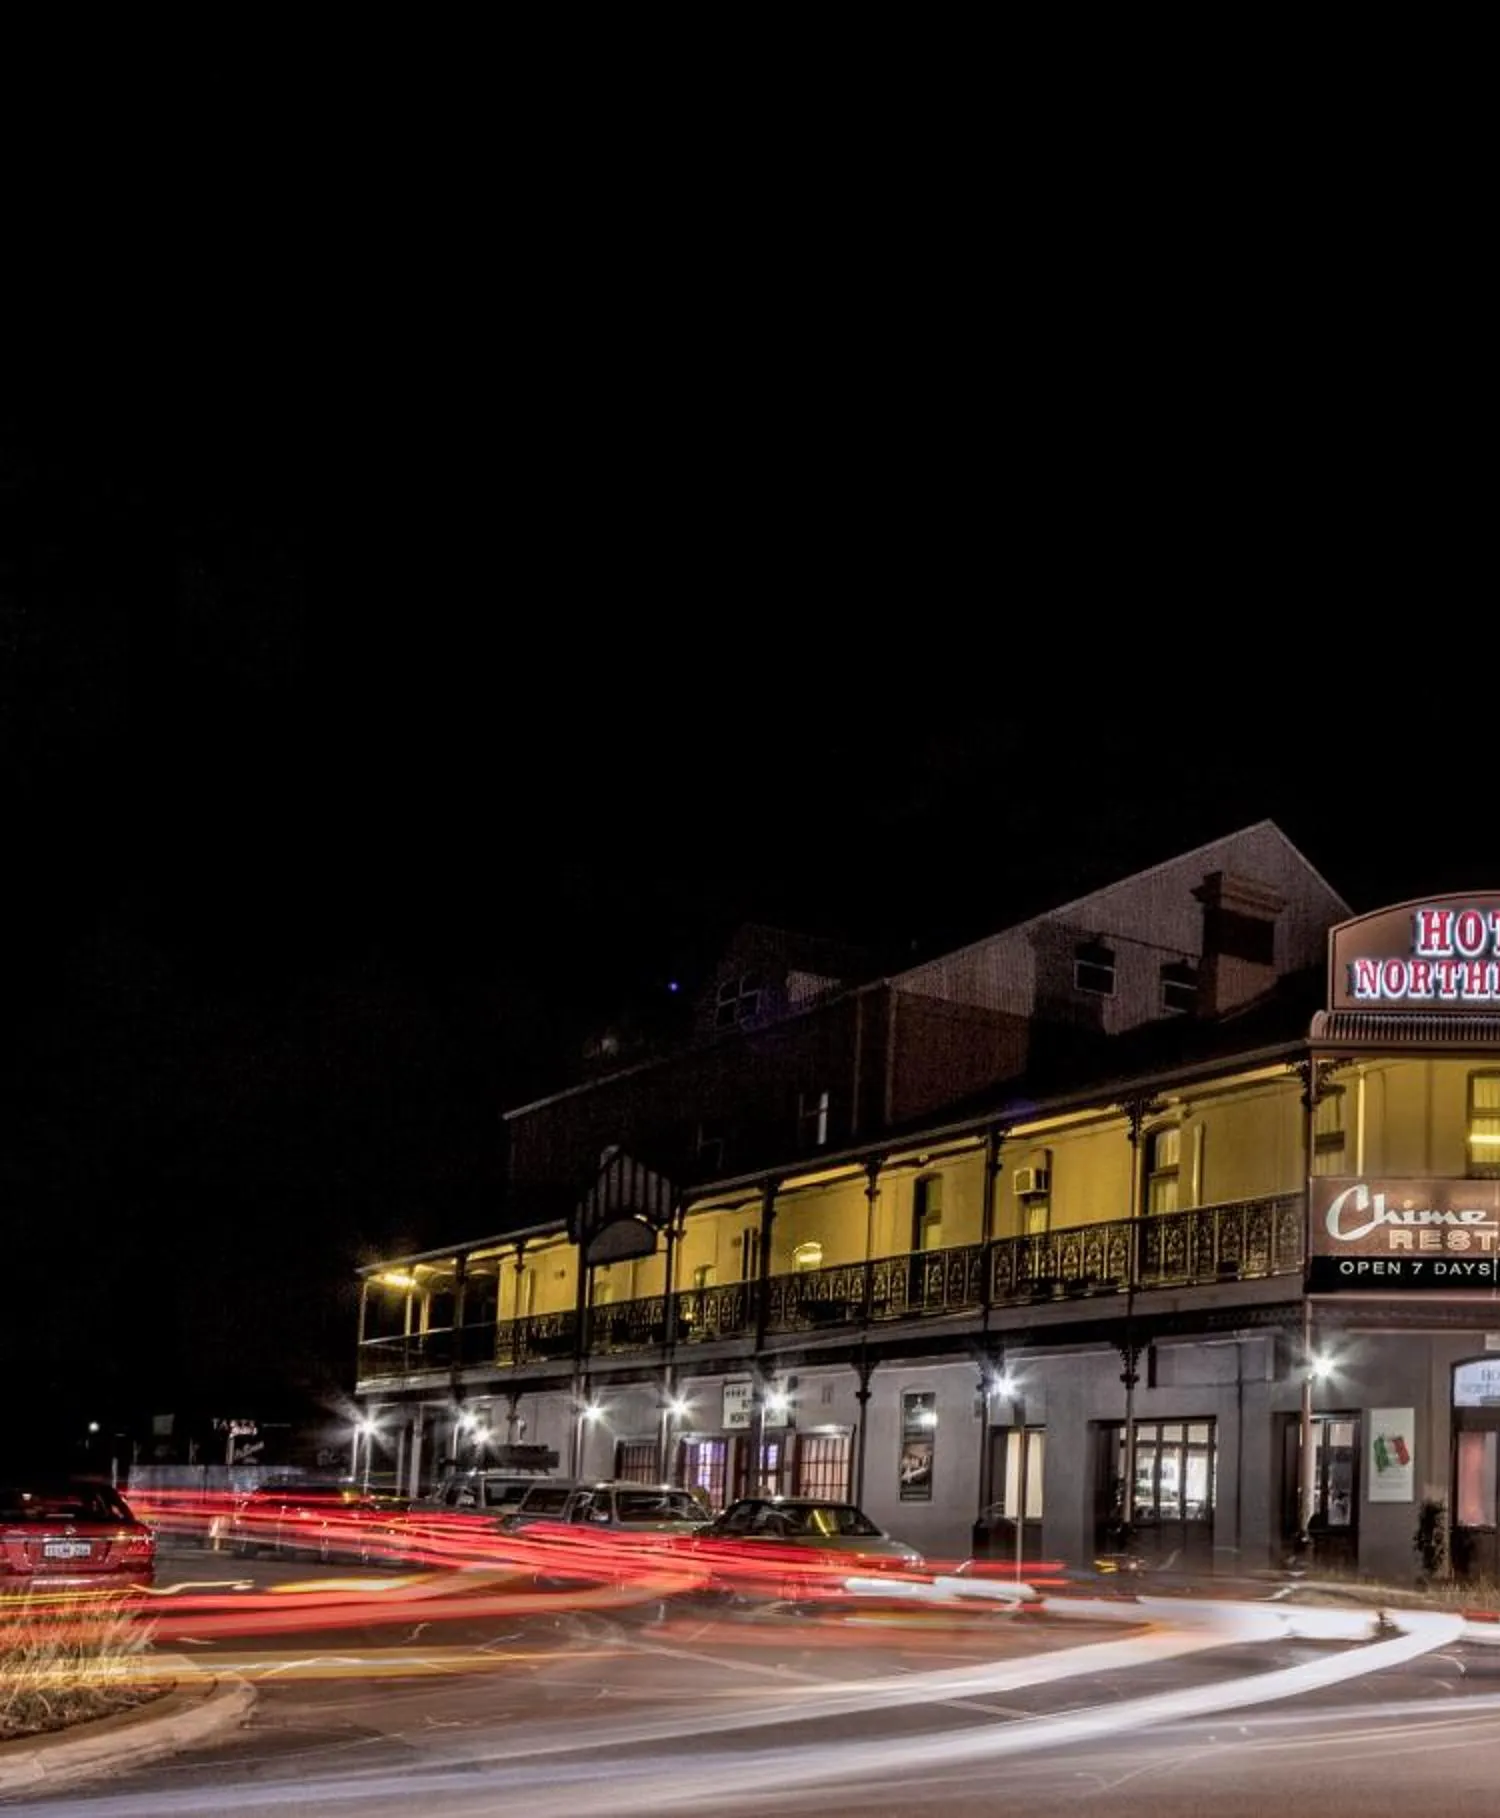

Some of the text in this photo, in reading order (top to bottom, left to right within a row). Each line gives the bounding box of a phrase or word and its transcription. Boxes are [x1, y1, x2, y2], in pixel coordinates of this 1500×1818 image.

[1325, 1183, 1499, 1241] Chime
[1339, 1261, 1402, 1275] OPEN
[1411, 1262, 1424, 1276] 7
[1433, 1262, 1492, 1277] DAYS
